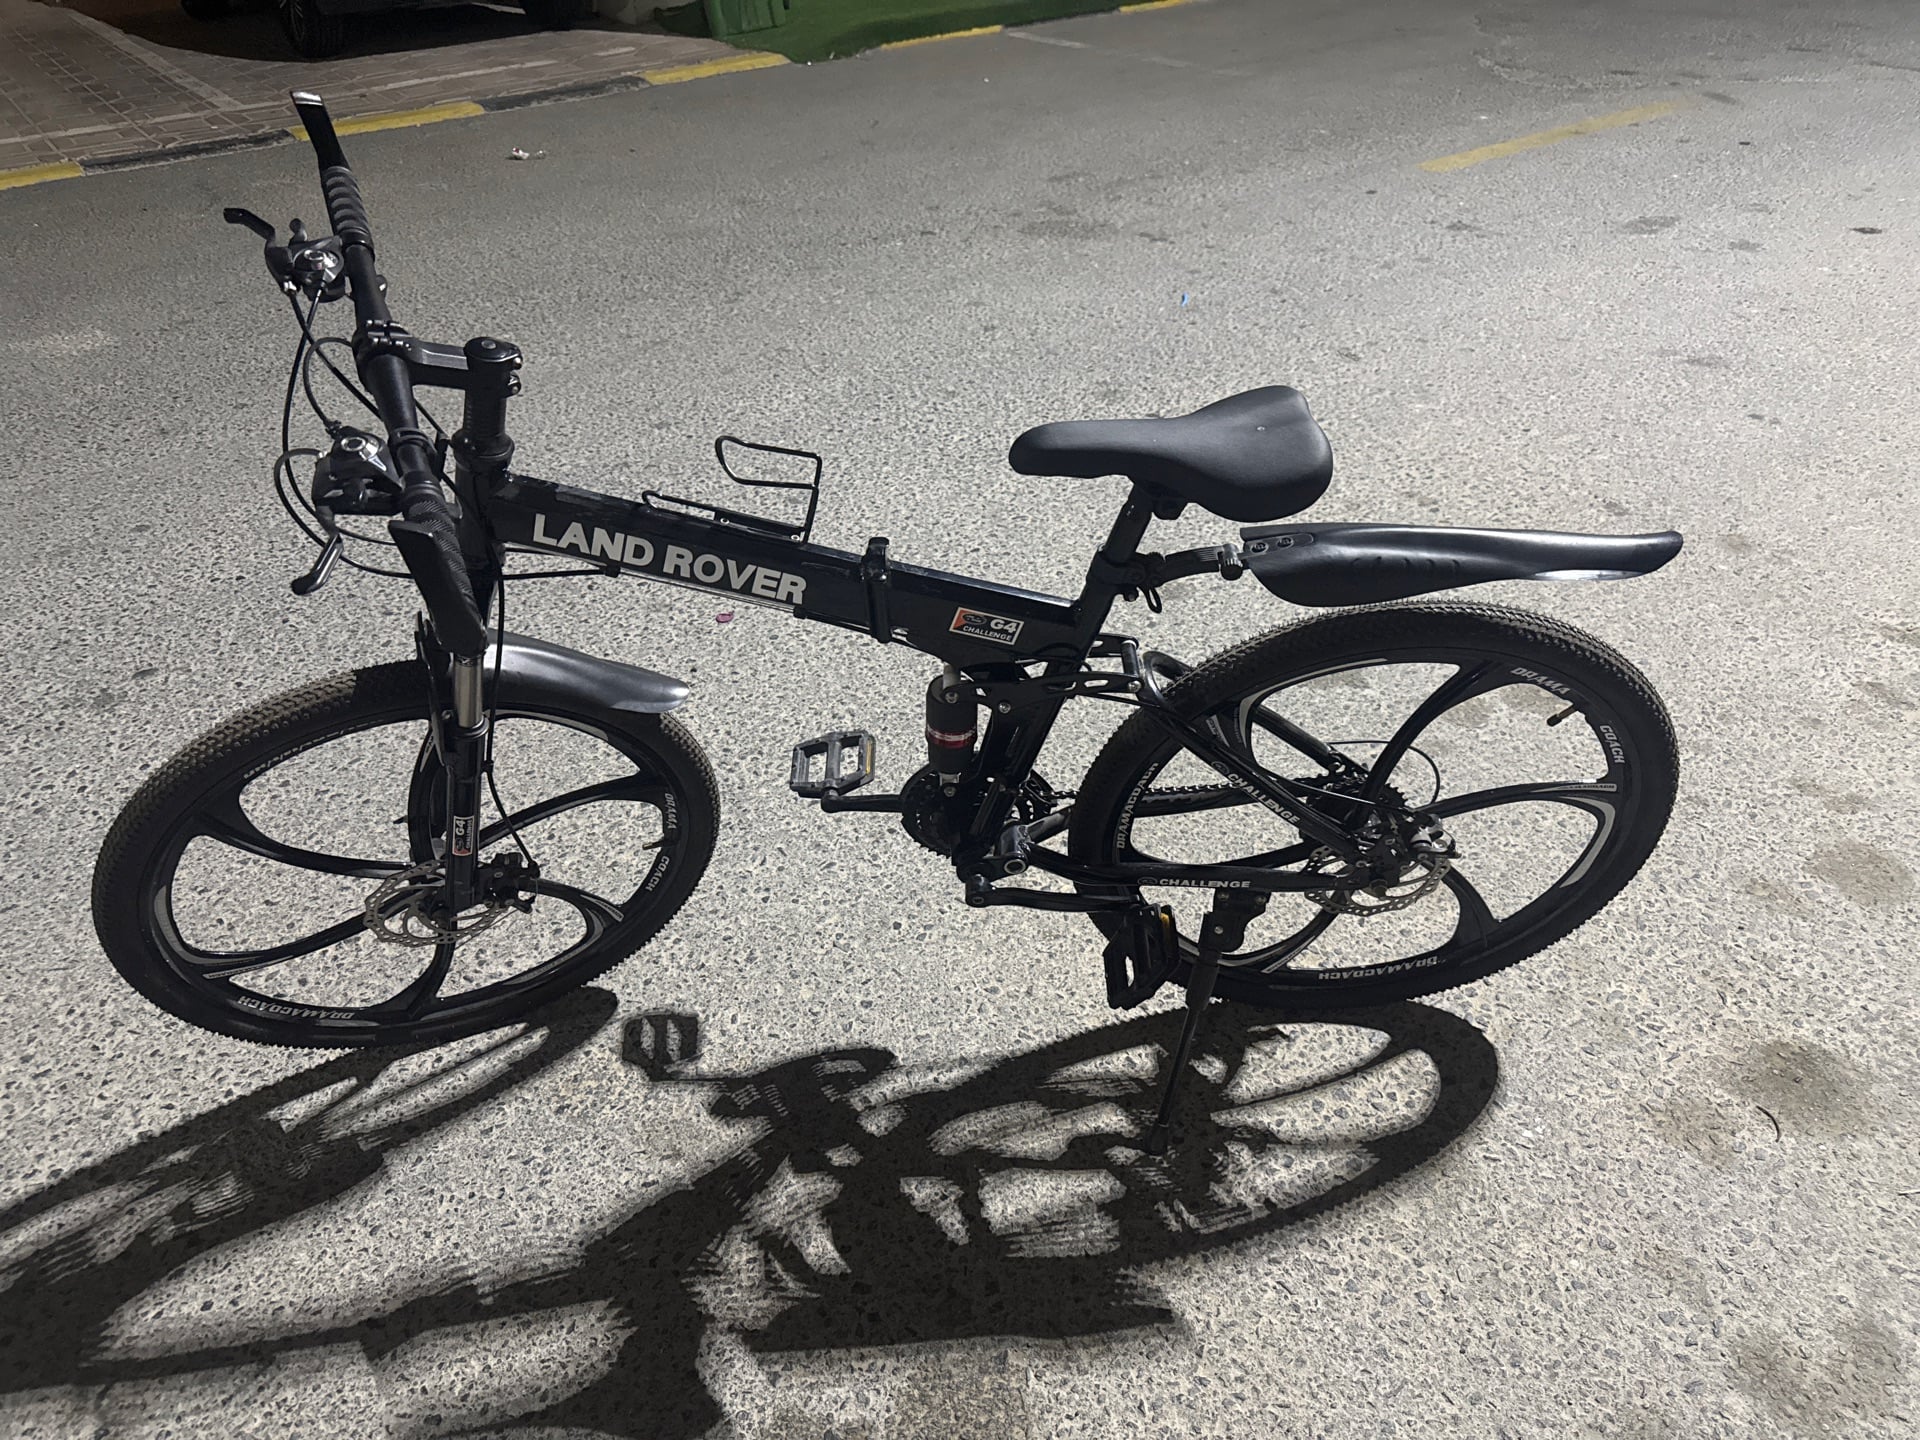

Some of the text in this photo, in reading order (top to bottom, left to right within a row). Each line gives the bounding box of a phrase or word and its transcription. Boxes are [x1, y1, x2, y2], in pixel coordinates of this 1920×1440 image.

[532, 513, 807, 605] LAND ROVER
[962, 625, 1013, 641] CHALLENGE
[990, 618, 1017, 634] G4
[1227, 773, 1301, 824] CHALLENGE
[455, 819, 466, 836] G4
[1159, 878, 1251, 888] CHALLENGE
